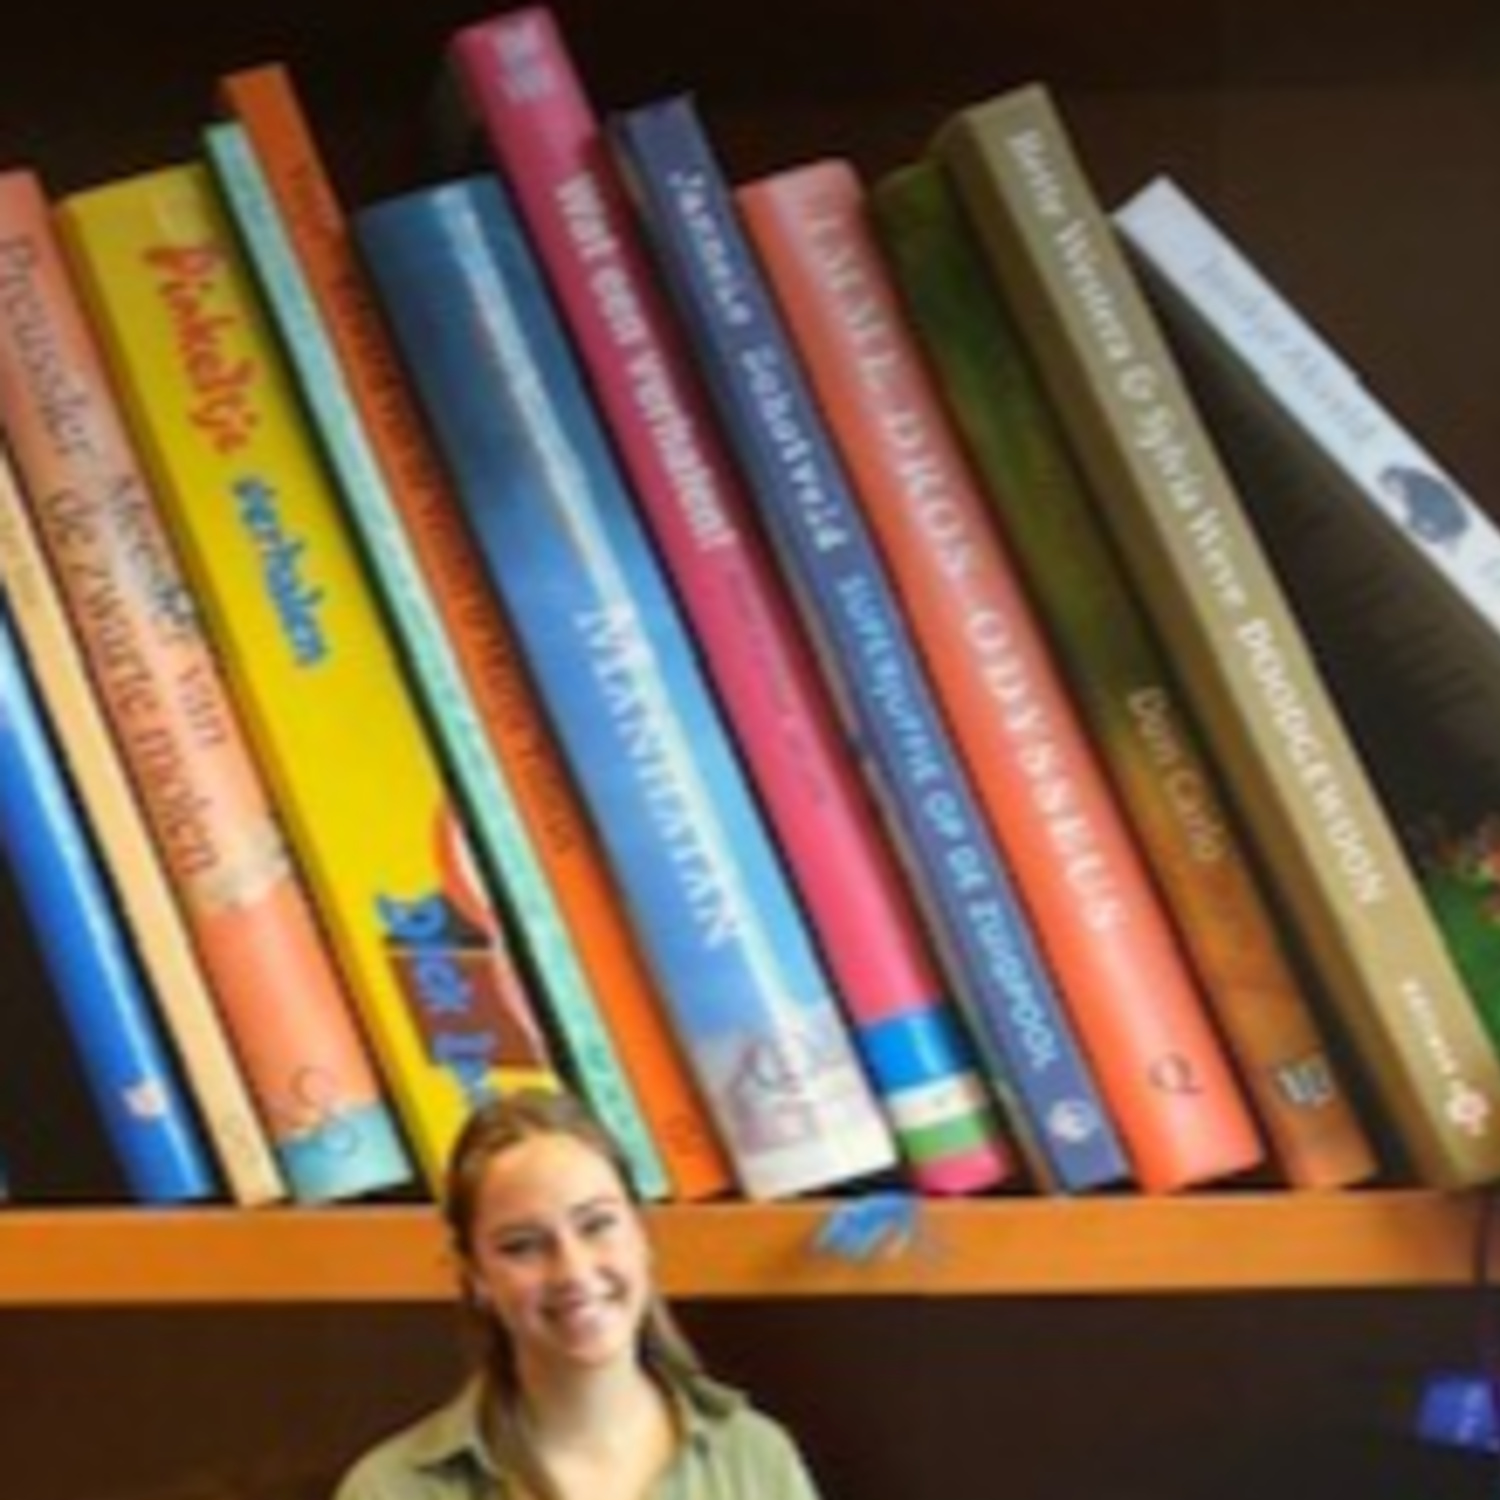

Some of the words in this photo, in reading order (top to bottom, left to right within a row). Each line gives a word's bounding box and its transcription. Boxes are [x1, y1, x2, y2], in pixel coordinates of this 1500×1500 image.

[0, 228, 101, 464] Preussler
[131, 226, 284, 462] Pinkeltje
[227, 468, 343, 670] verhalen
[552, 172, 617, 263] Wat
[588, 263, 647, 348] een
[623, 346, 735, 555] verhalen!
[664, 163, 758, 329] Janneke
[737, 340, 851, 554] Schotveld
[1004, 124, 1074, 221] Bette
[1047, 218, 1141, 365] Westera
[1124, 401, 1210, 517] Sylvia
[1181, 506, 1254, 612] Weve
[38, 482, 100, 548] de
[802, 212, 903, 392] IMME
[879, 400, 980, 580] DROS
[961, 602, 1126, 937] ODYSSEUS
[65, 552, 163, 719] zwarte
[170, 662, 233, 752] van
[130, 718, 232, 878] molen
[1125, 682, 1187, 768] Don
[1160, 764, 1230, 867] Carlo
